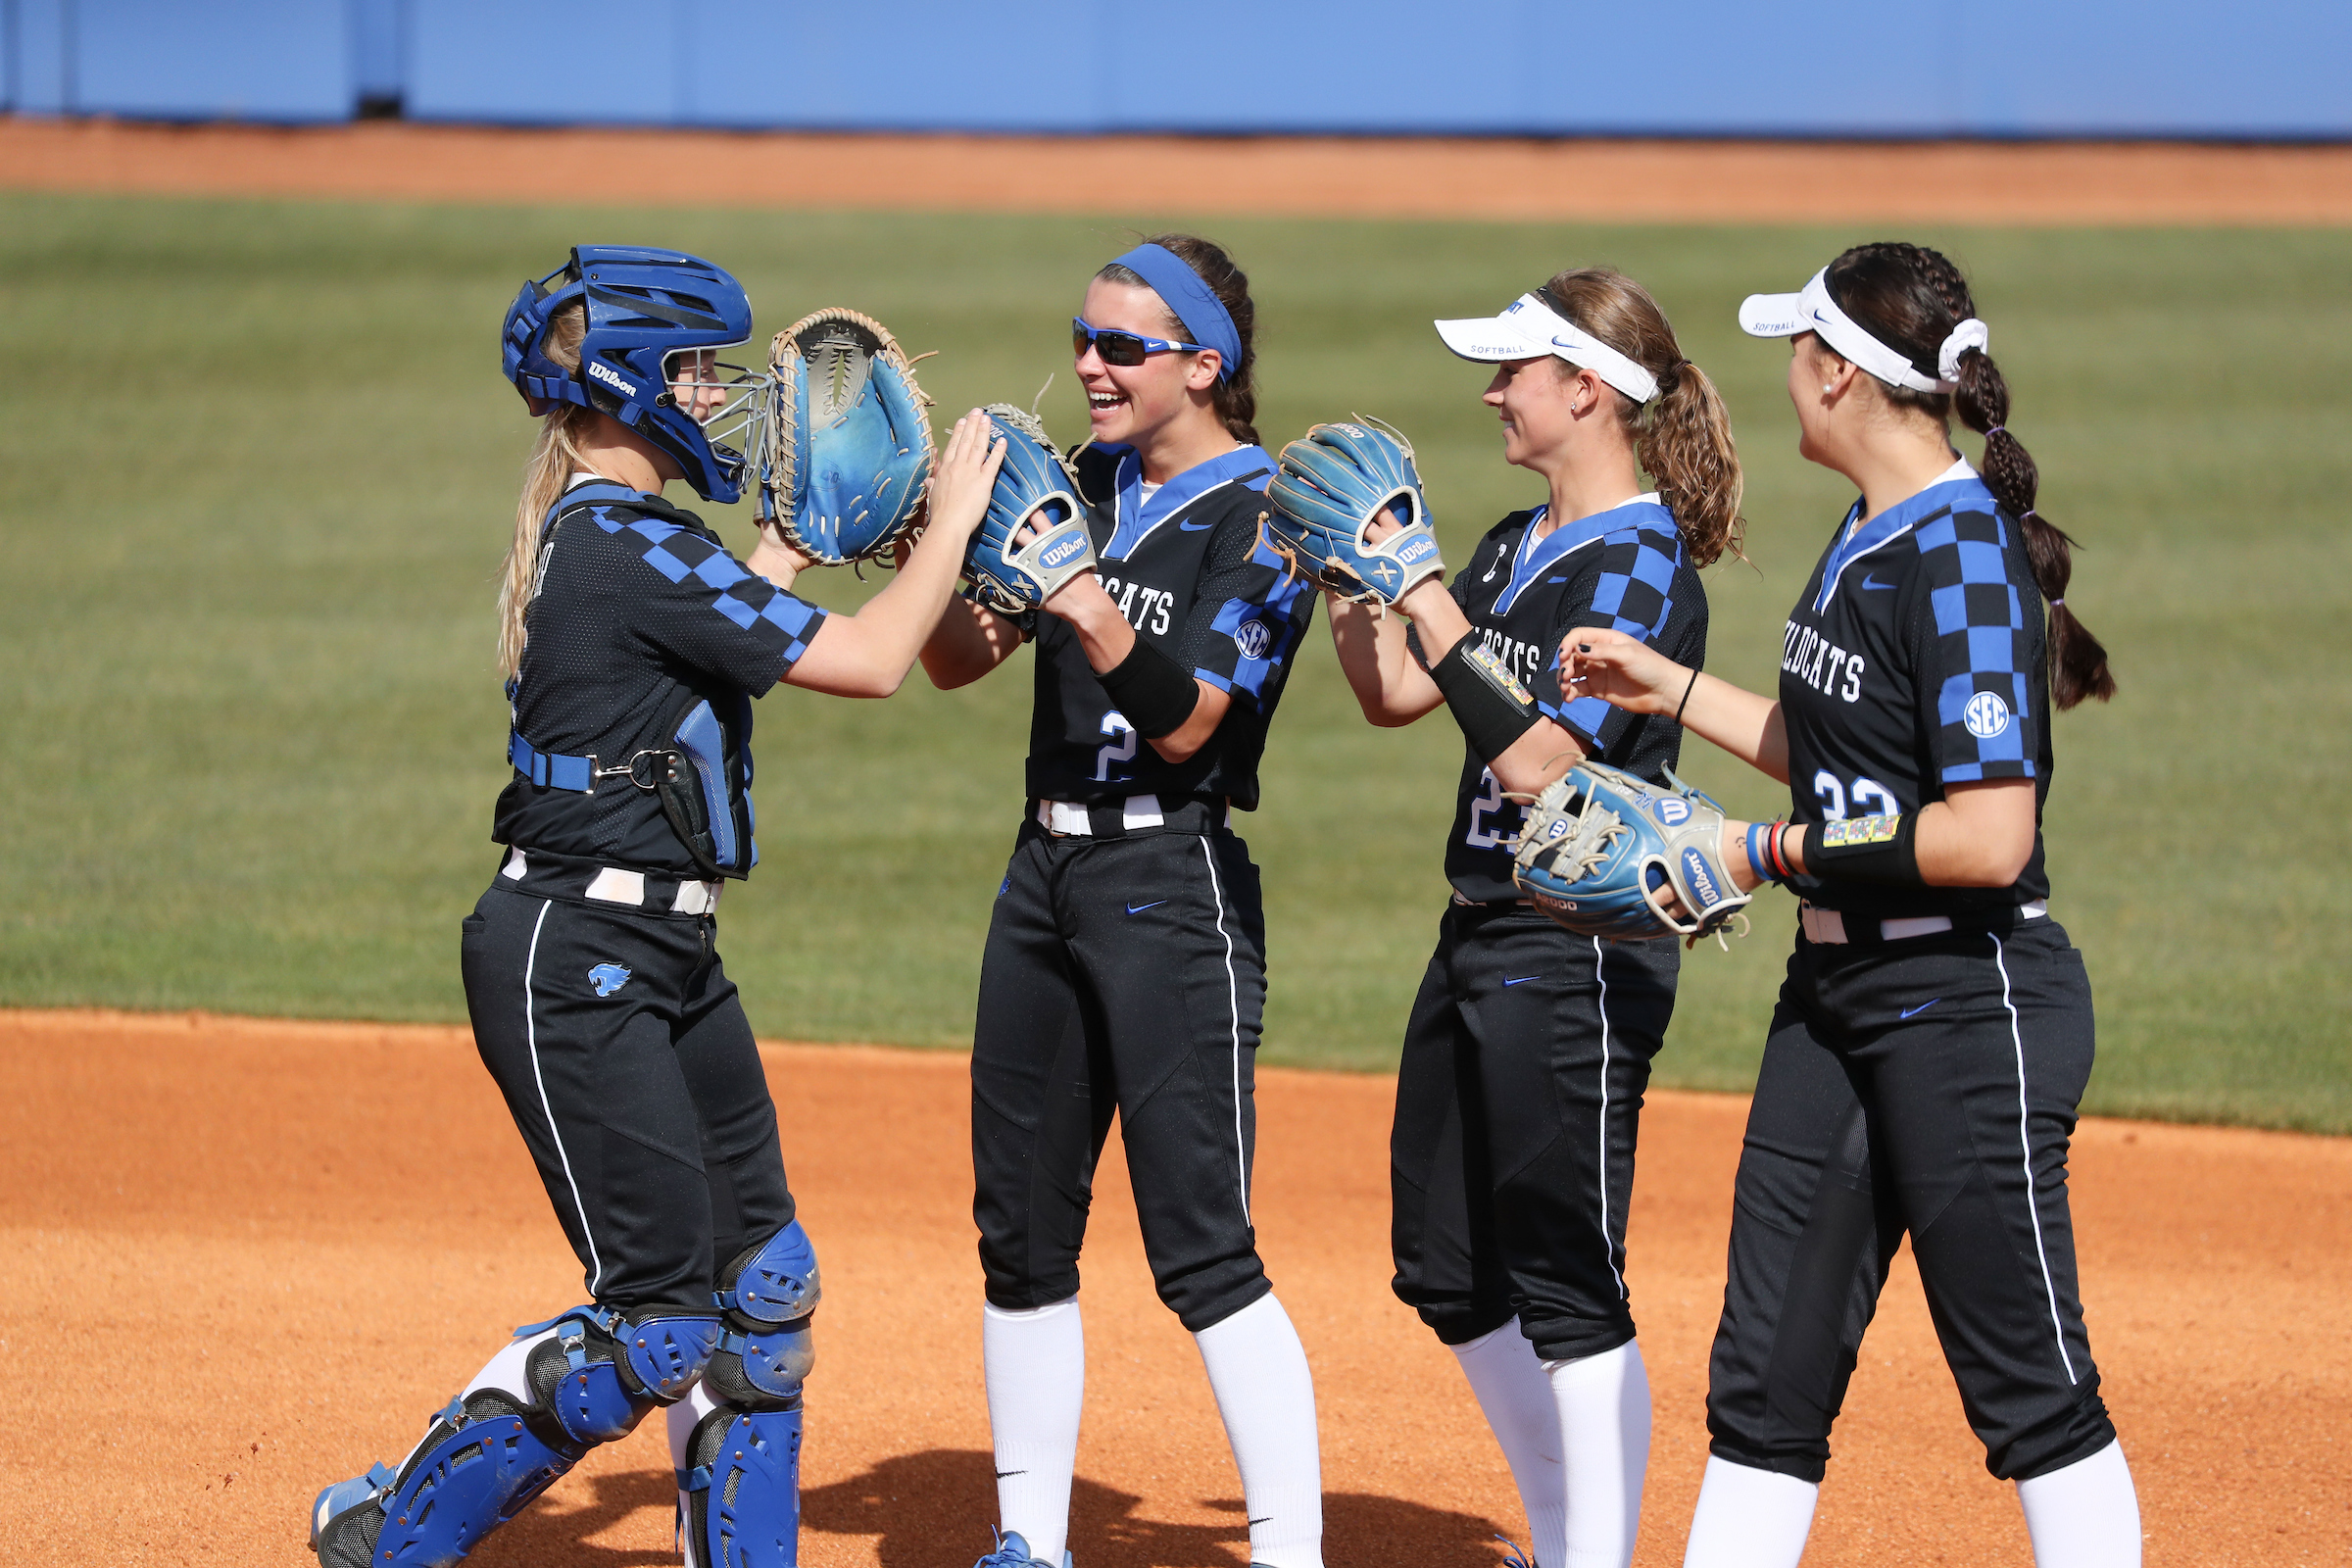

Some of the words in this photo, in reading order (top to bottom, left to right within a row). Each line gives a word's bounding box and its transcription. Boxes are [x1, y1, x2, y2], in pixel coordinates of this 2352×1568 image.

[1752, 319, 1795, 332] SOFTBALL
[1470, 344, 1526, 355] SOFTBALL
[588, 361, 637, 397] Wilson
[1042, 535, 1087, 565] Wilson
[1398, 540, 1437, 563] Wilson
[1482, 543, 1507, 583] C
[1093, 573, 1174, 636] CATS
[1236, 620, 1269, 659] SEC
[1476, 626, 1540, 685] CATS
[1966, 693, 2007, 736] SEC
[1088, 710, 1138, 783] 2
[1465, 763, 1530, 856] 2
[1688, 852, 1720, 906] Wilson
